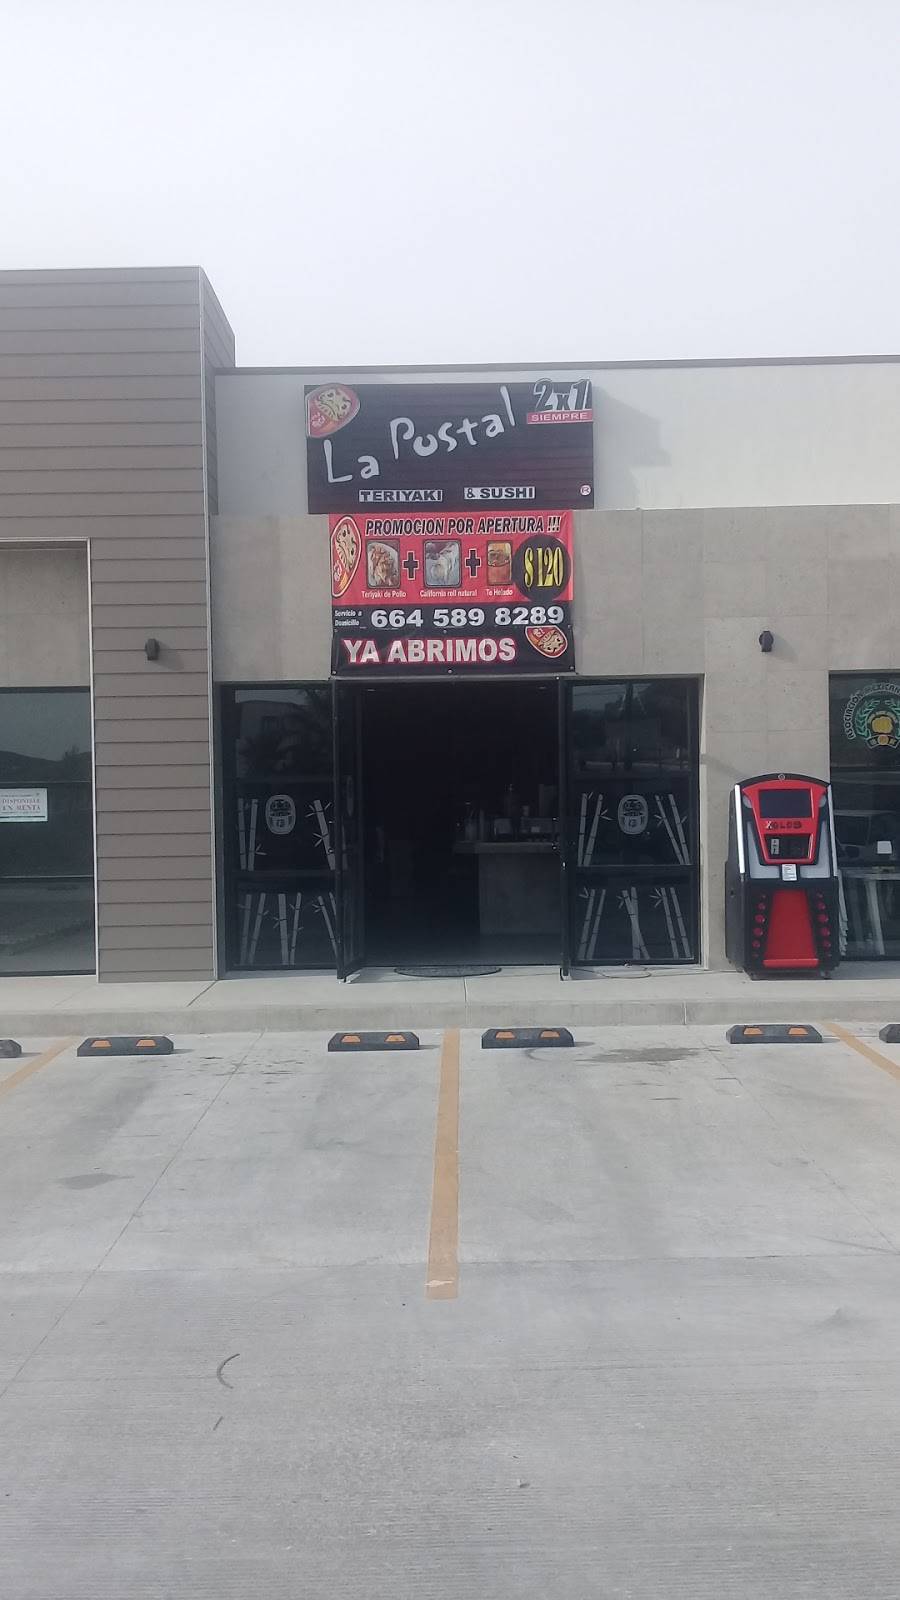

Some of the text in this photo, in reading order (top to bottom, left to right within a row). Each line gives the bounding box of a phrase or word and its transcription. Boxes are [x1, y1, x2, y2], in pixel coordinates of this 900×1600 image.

[533, 377, 592, 411] 2x1
[531, 412, 588, 422] SIEMPRE
[323, 385, 515, 483] La Postal
[360, 487, 535, 502] TERIYAKI & SUSHI
[365, 518, 444, 536] PROMOCION
[448, 517, 476, 535] POR
[478, 516, 544, 534] APERTURA
[361, 590, 406, 599] Teriyaki de Pollo
[420, 588, 477, 598] California roll natural
[494, 588, 513, 596] Helado
[335, 609, 356, 617] Servicio
[371, 605, 564, 628] 664 589 8289
[343, 638, 516, 663] YA ABRIMOS
